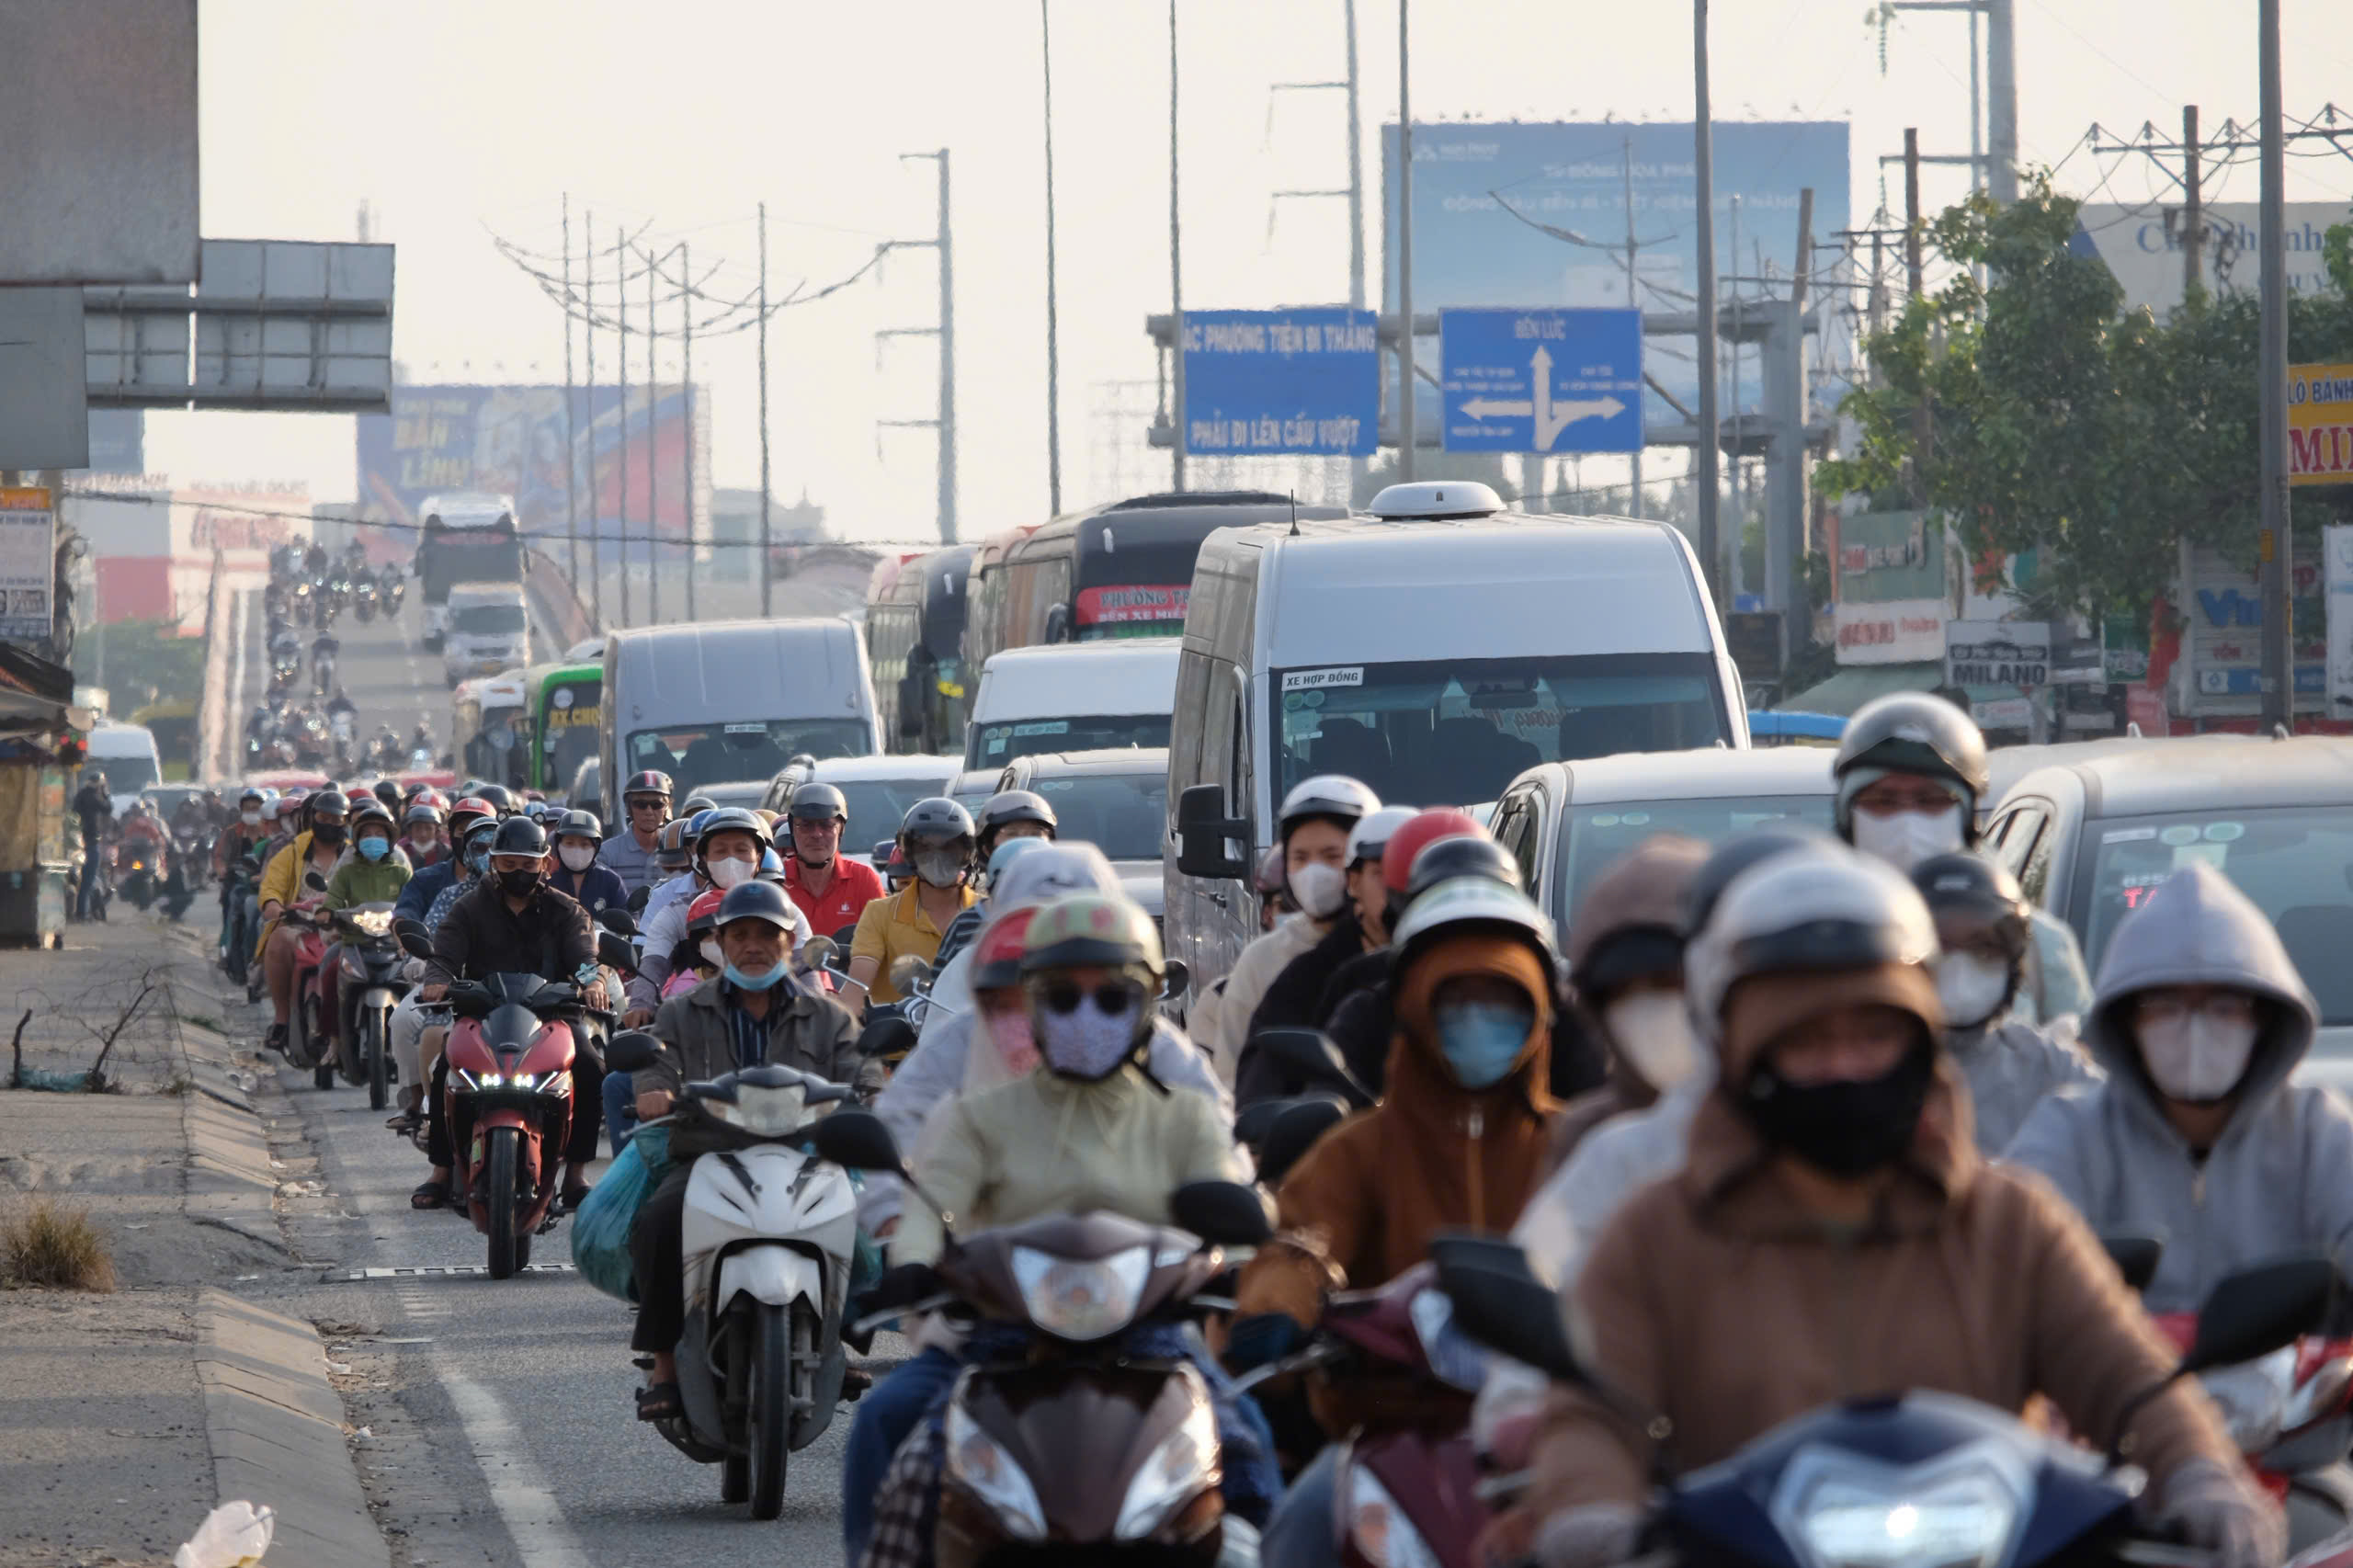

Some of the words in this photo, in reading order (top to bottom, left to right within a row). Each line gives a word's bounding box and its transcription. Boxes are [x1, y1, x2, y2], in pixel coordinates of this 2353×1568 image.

[1183, 317, 1201, 353] ÁC
[2288, 426, 2353, 472] MI
[1100, 586, 1168, 608] PHƯƠNG
[1132, 610, 1153, 620] XE
[1155, 607, 1186, 619] MIỀ
[1287, 676, 1301, 687] XE
[1303, 674, 1325, 686] HỢP
[1951, 664, 2047, 685] MILANO
